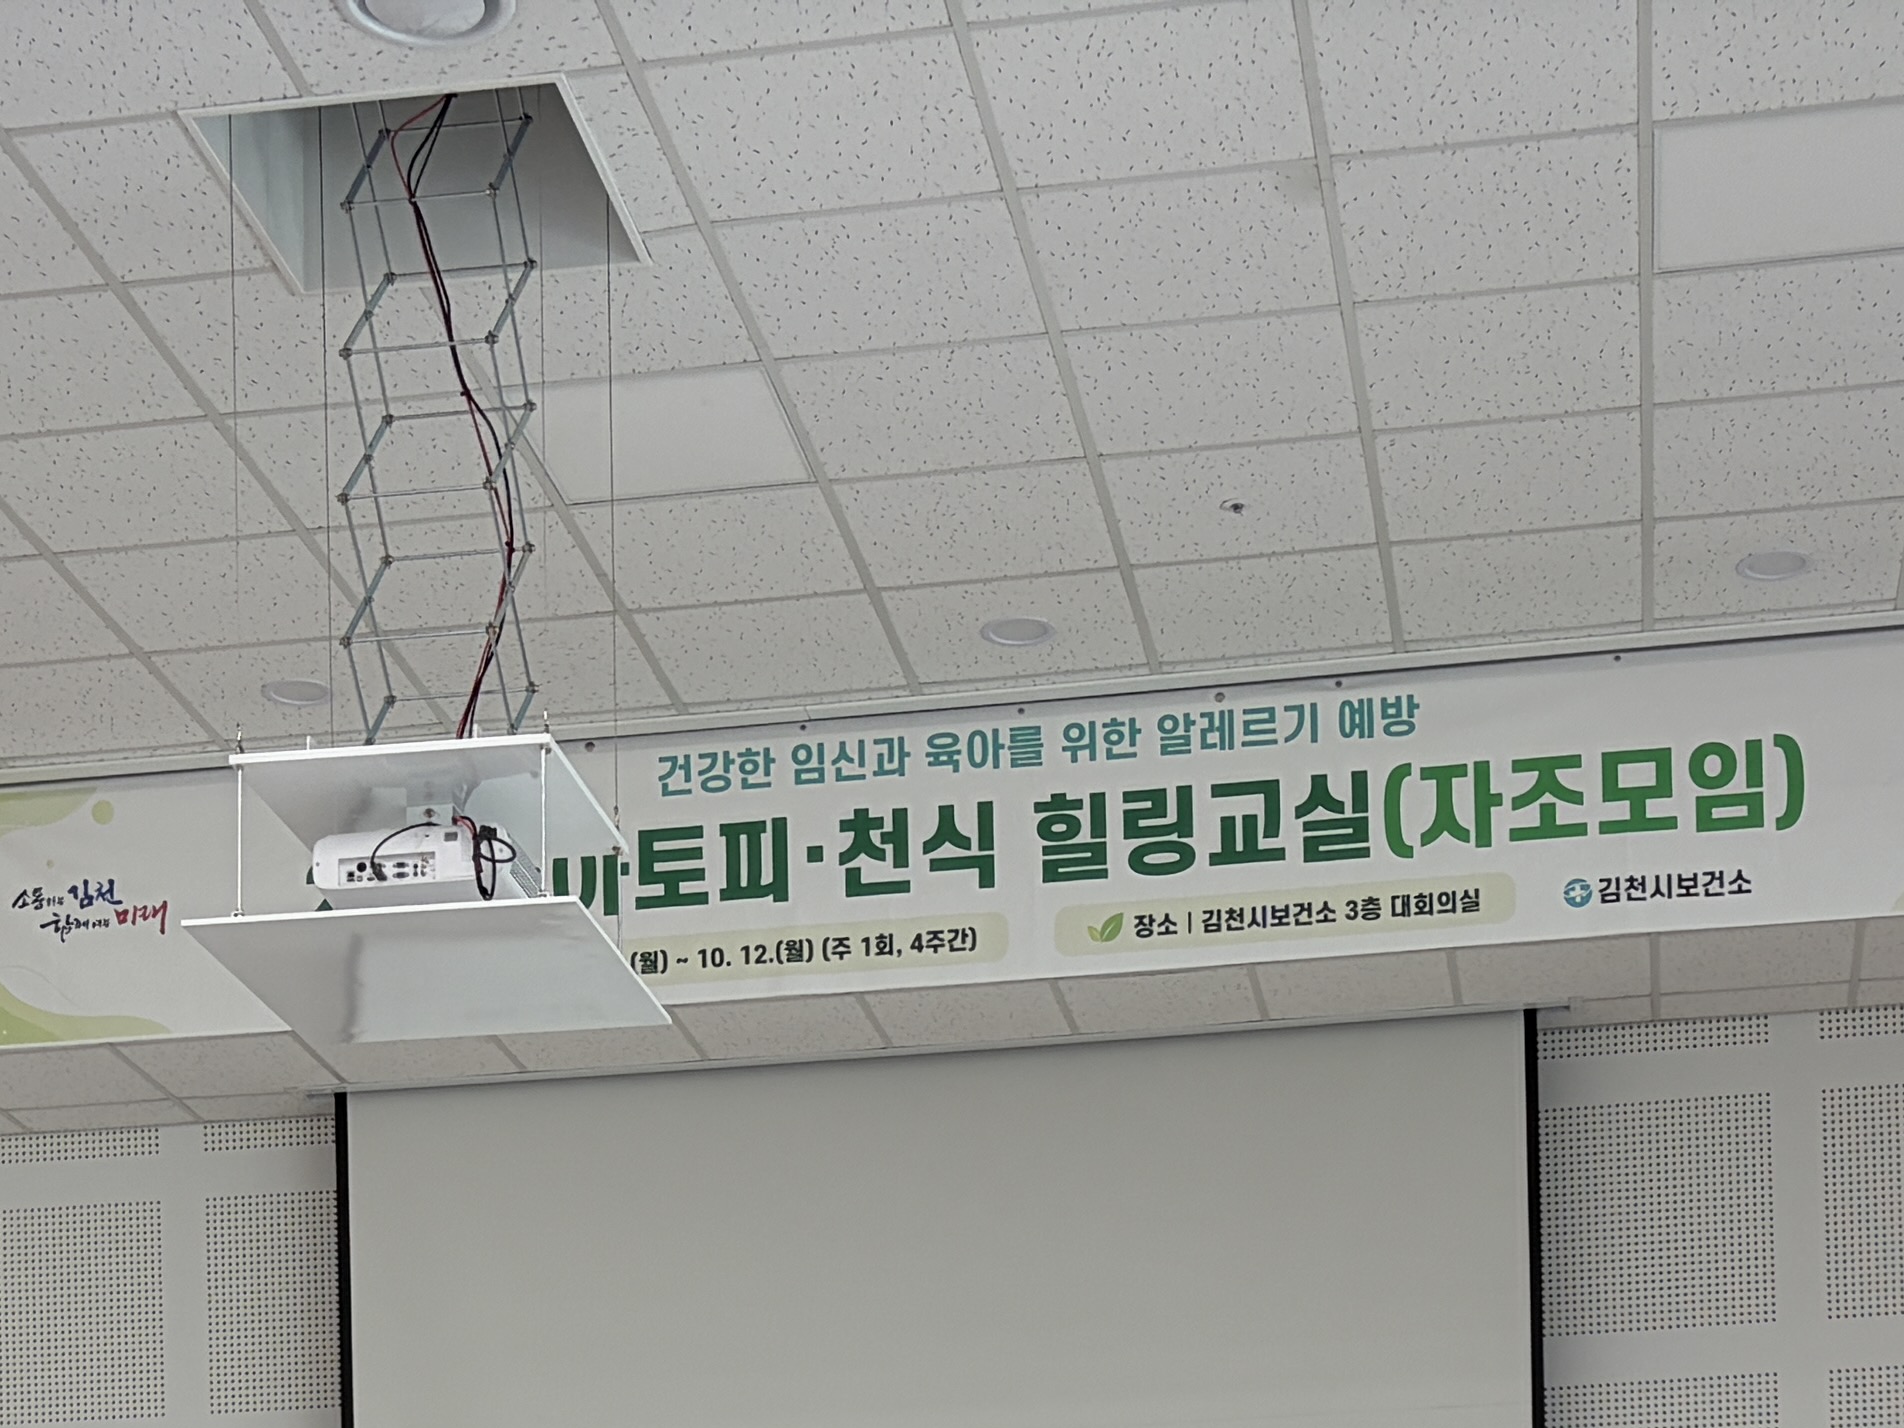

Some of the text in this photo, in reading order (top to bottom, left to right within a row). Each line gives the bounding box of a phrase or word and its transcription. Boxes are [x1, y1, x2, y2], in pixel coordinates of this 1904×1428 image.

[657, 693, 1421, 797] 건강한 임신과 육아를 위한 알레르기 예방
[1033, 733, 1806, 884] 힐링교실(자조모임)
[1598, 868, 1753, 905] 김천시보건소
[114, 900, 168, 935] 미래
[1134, 887, 1481, 939] 장소 김천시보건소 3층 대회의실
[743, 938, 815, 966] 12.(월)
[822, 935, 852, 962] (주
[862, 932, 903, 958] 1회,
[910, 926, 978, 955] 4주간)
